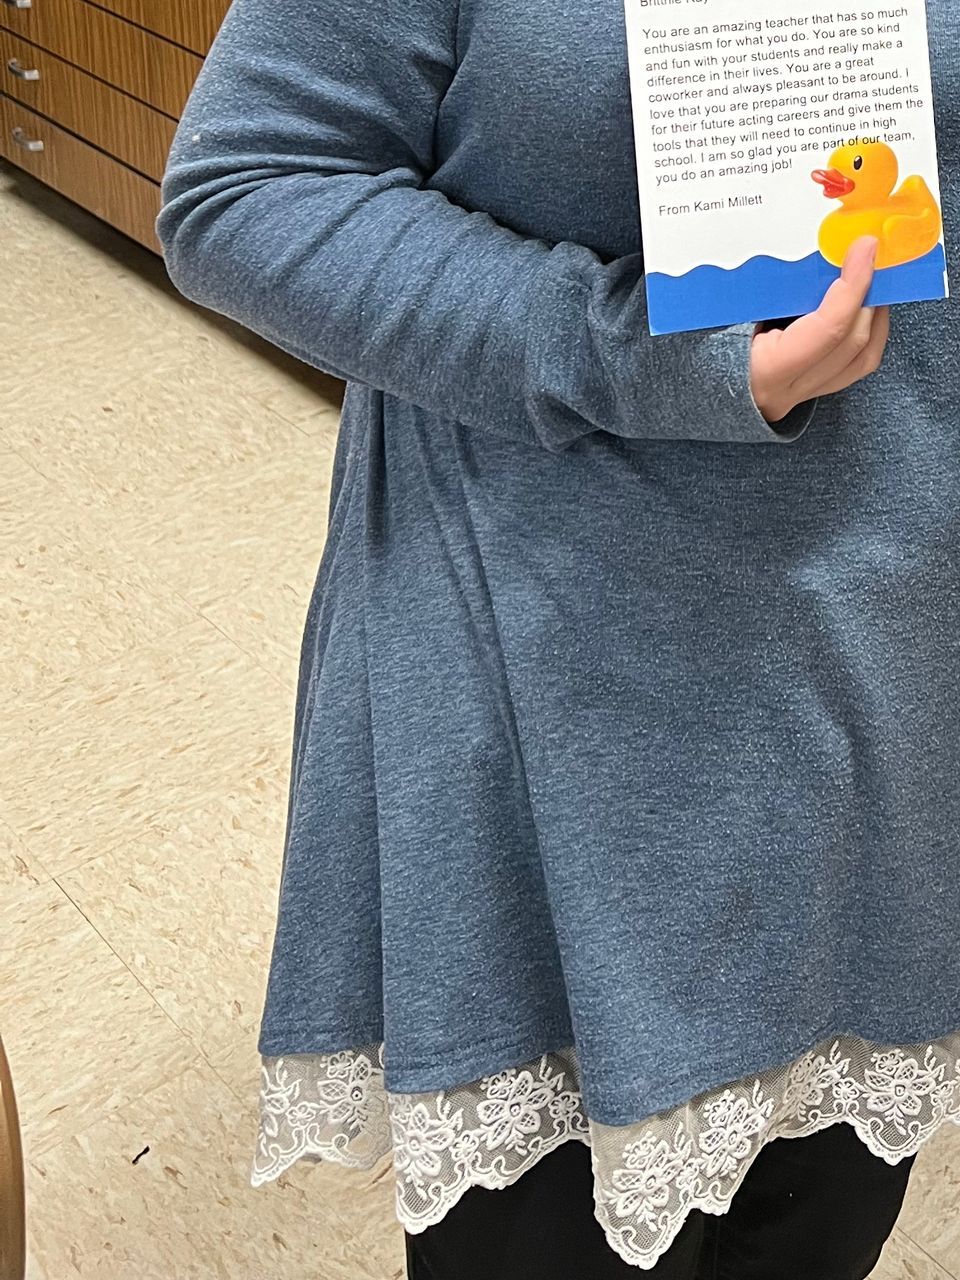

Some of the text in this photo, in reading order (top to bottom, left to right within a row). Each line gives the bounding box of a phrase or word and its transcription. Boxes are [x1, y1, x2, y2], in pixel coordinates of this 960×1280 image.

[642, 7, 908, 39] You are an amazing teacher that has so much
[644, 22, 900, 55] enthusiasm for what you do. You are so kind
[645, 39, 903, 72] and fun with your students and really make a
[647, 56, 875, 87] difference in their lives. You are a great
[648, 68, 909, 103] coworker and always pleasant to be around. I
[649, 84, 919, 120] love that you are preparing our drama students
[651, 98, 924, 135] for their future acting careers and give them the
[653, 117, 897, 152] tools that they will need to continue in high
[654, 153, 697, 168] school.
[701, 152, 704, 163] I
[708, 151, 727, 162] am
[730, 150, 744, 160] so
[747, 145, 773, 160] glad
[776, 145, 797, 157] you
[800, 141, 819, 152] are
[822, 138, 845, 151] part
[848, 135, 859, 147] of
[862, 135, 881, 145] our
[656, 158, 792, 187] you do an amazing job!
[658, 194, 763, 216] From Kami Millett
